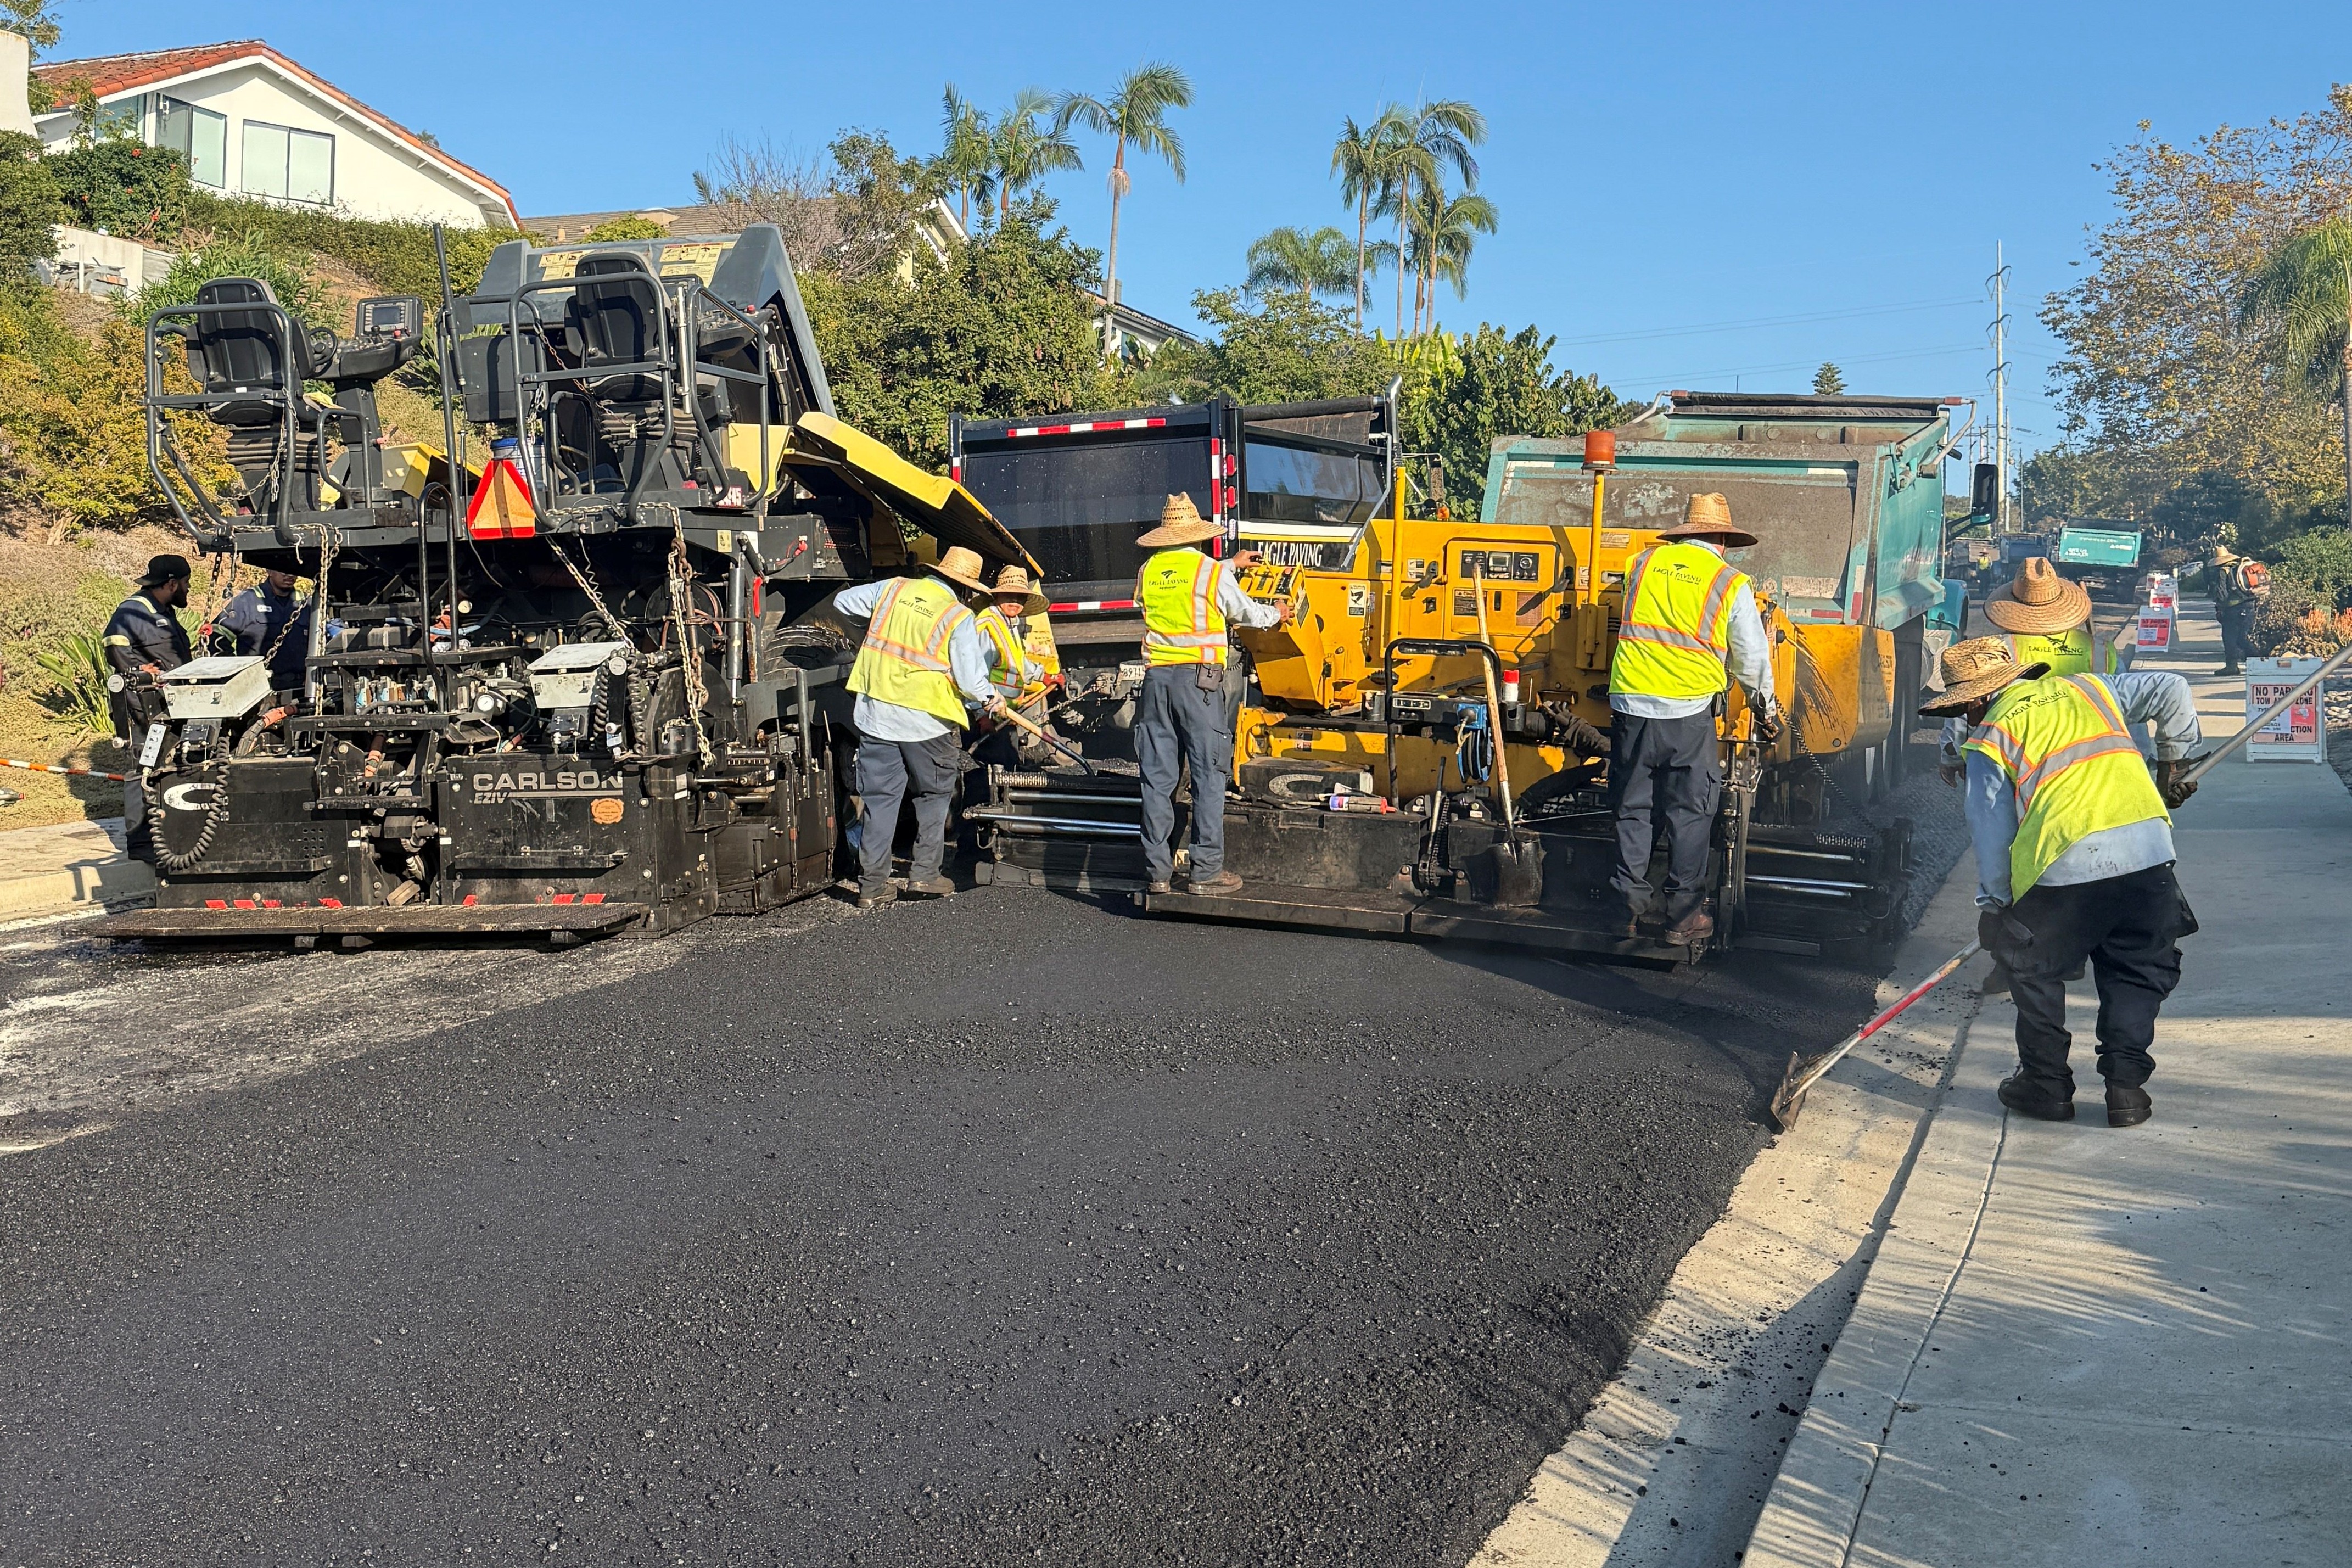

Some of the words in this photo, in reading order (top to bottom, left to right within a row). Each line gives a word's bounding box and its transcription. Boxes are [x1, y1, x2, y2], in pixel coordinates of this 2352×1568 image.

[1258, 541, 1287, 565] EAGLE
[1288, 542, 1323, 567] PAVING
[2255, 687, 2269, 696] NO
[2005, 703, 2032, 720] EAGLE
[2032, 690, 2067, 707] PAVING
[473, 771, 623, 791] CARLSON
